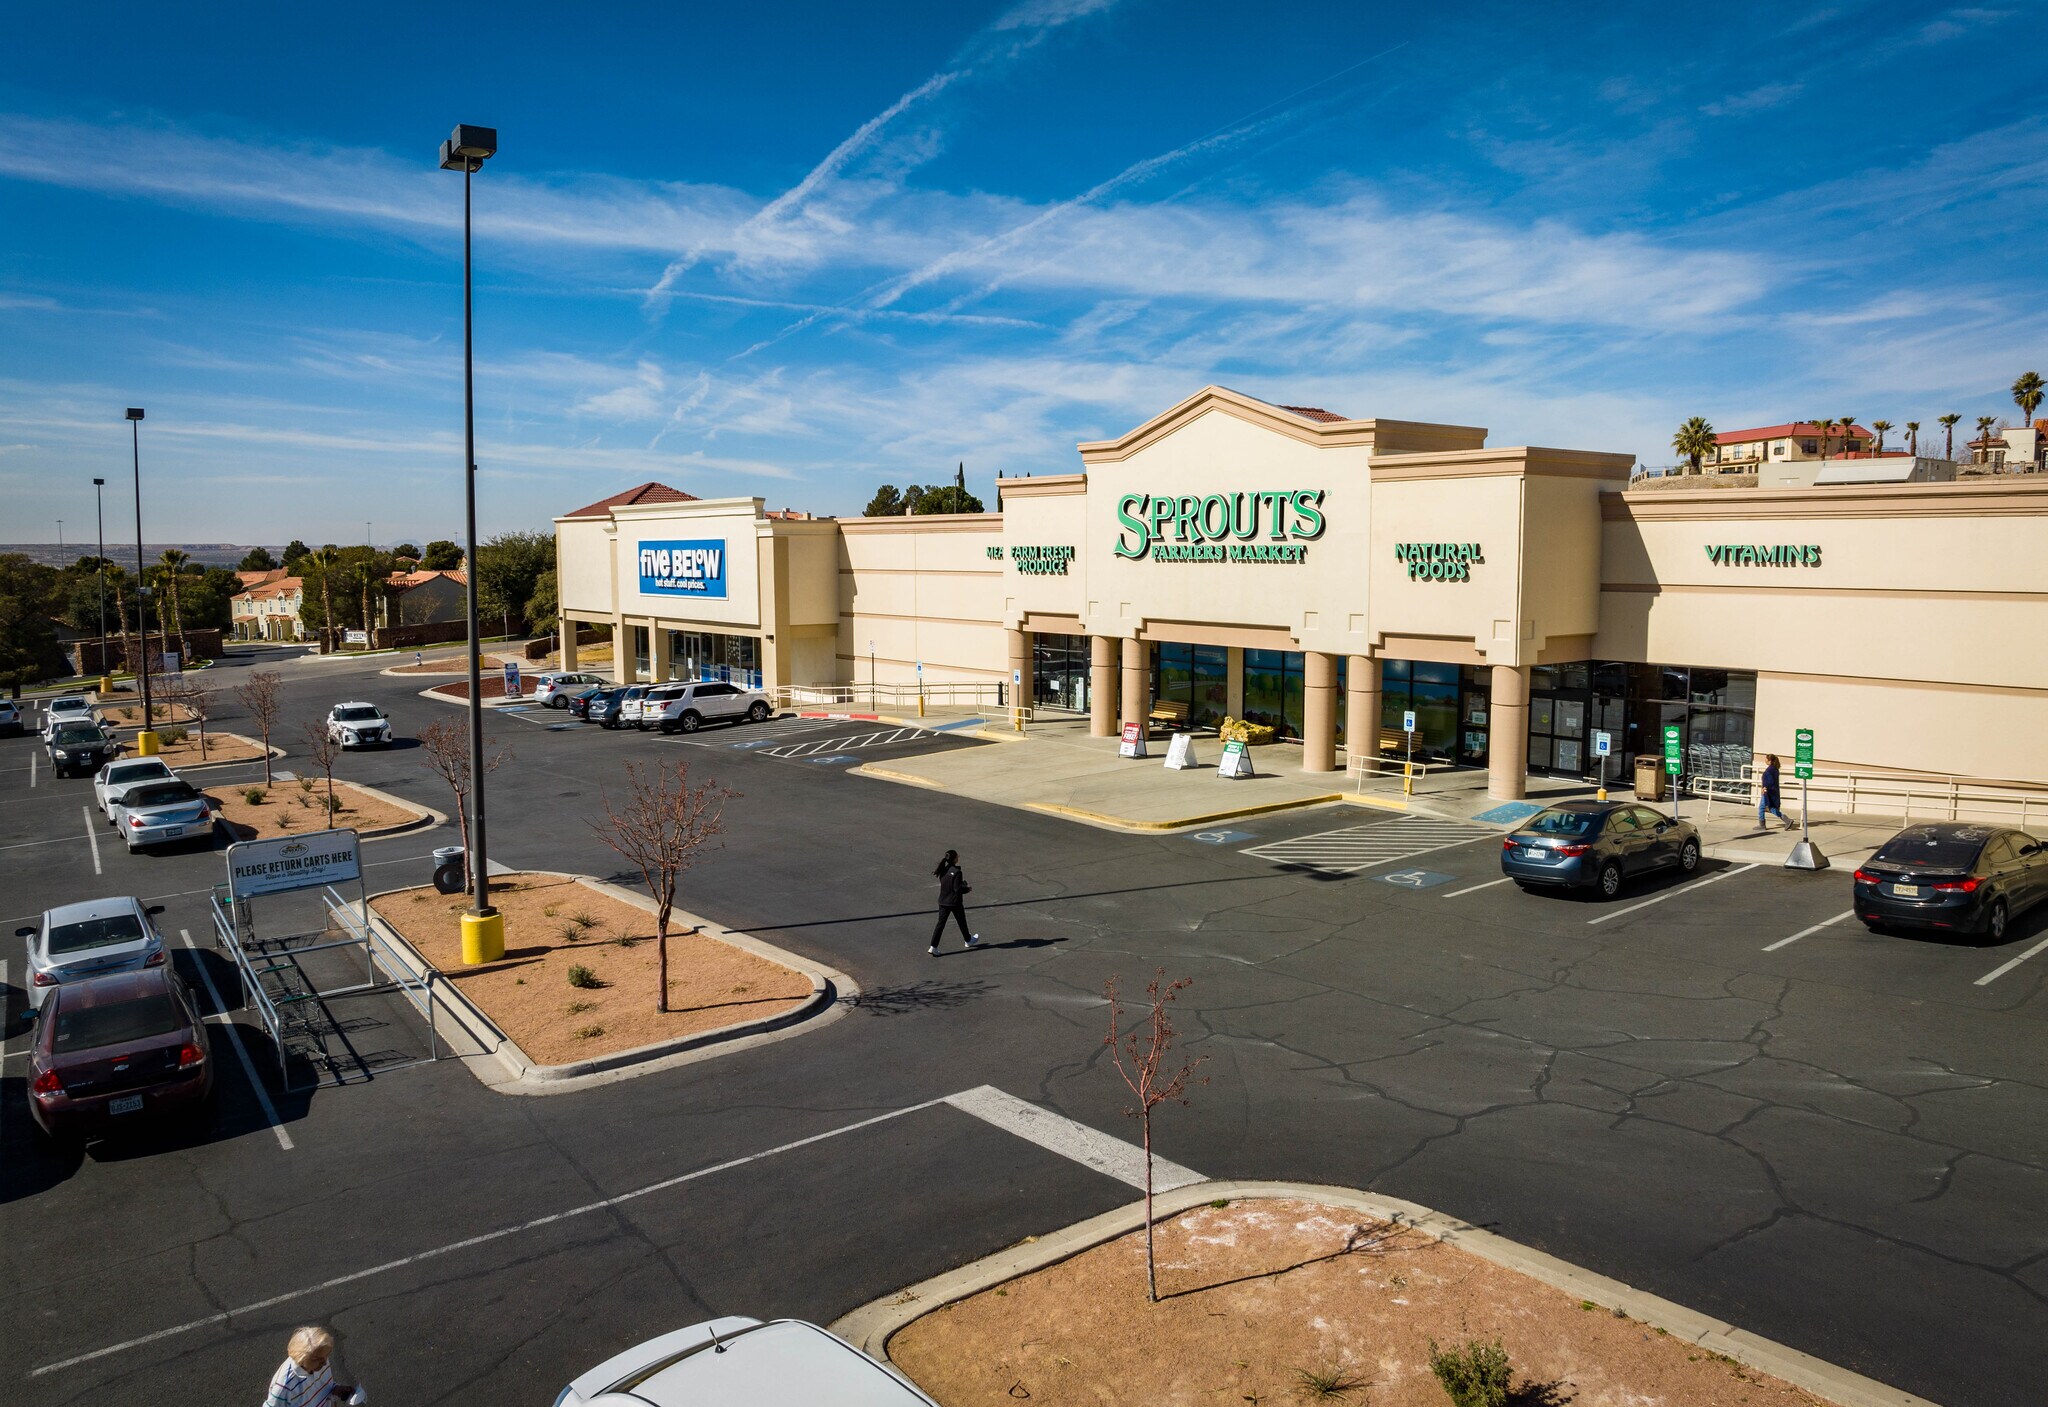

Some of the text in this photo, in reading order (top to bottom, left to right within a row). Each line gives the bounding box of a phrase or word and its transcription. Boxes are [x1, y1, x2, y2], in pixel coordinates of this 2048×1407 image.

[1113, 489, 1323, 558] SPROUTS
[1010, 545, 1073, 560] FARM FRESH
[1150, 544, 1305, 561] FARMERS MARKET
[1394, 543, 1481, 560] NATURAL
[1703, 544, 1820, 563] VITAMINS
[1016, 559, 1065, 574] PRODUCE
[1407, 560, 1467, 579] FOODS
[235, 850, 353, 878] PLEASE RETURN CARTS HERE
